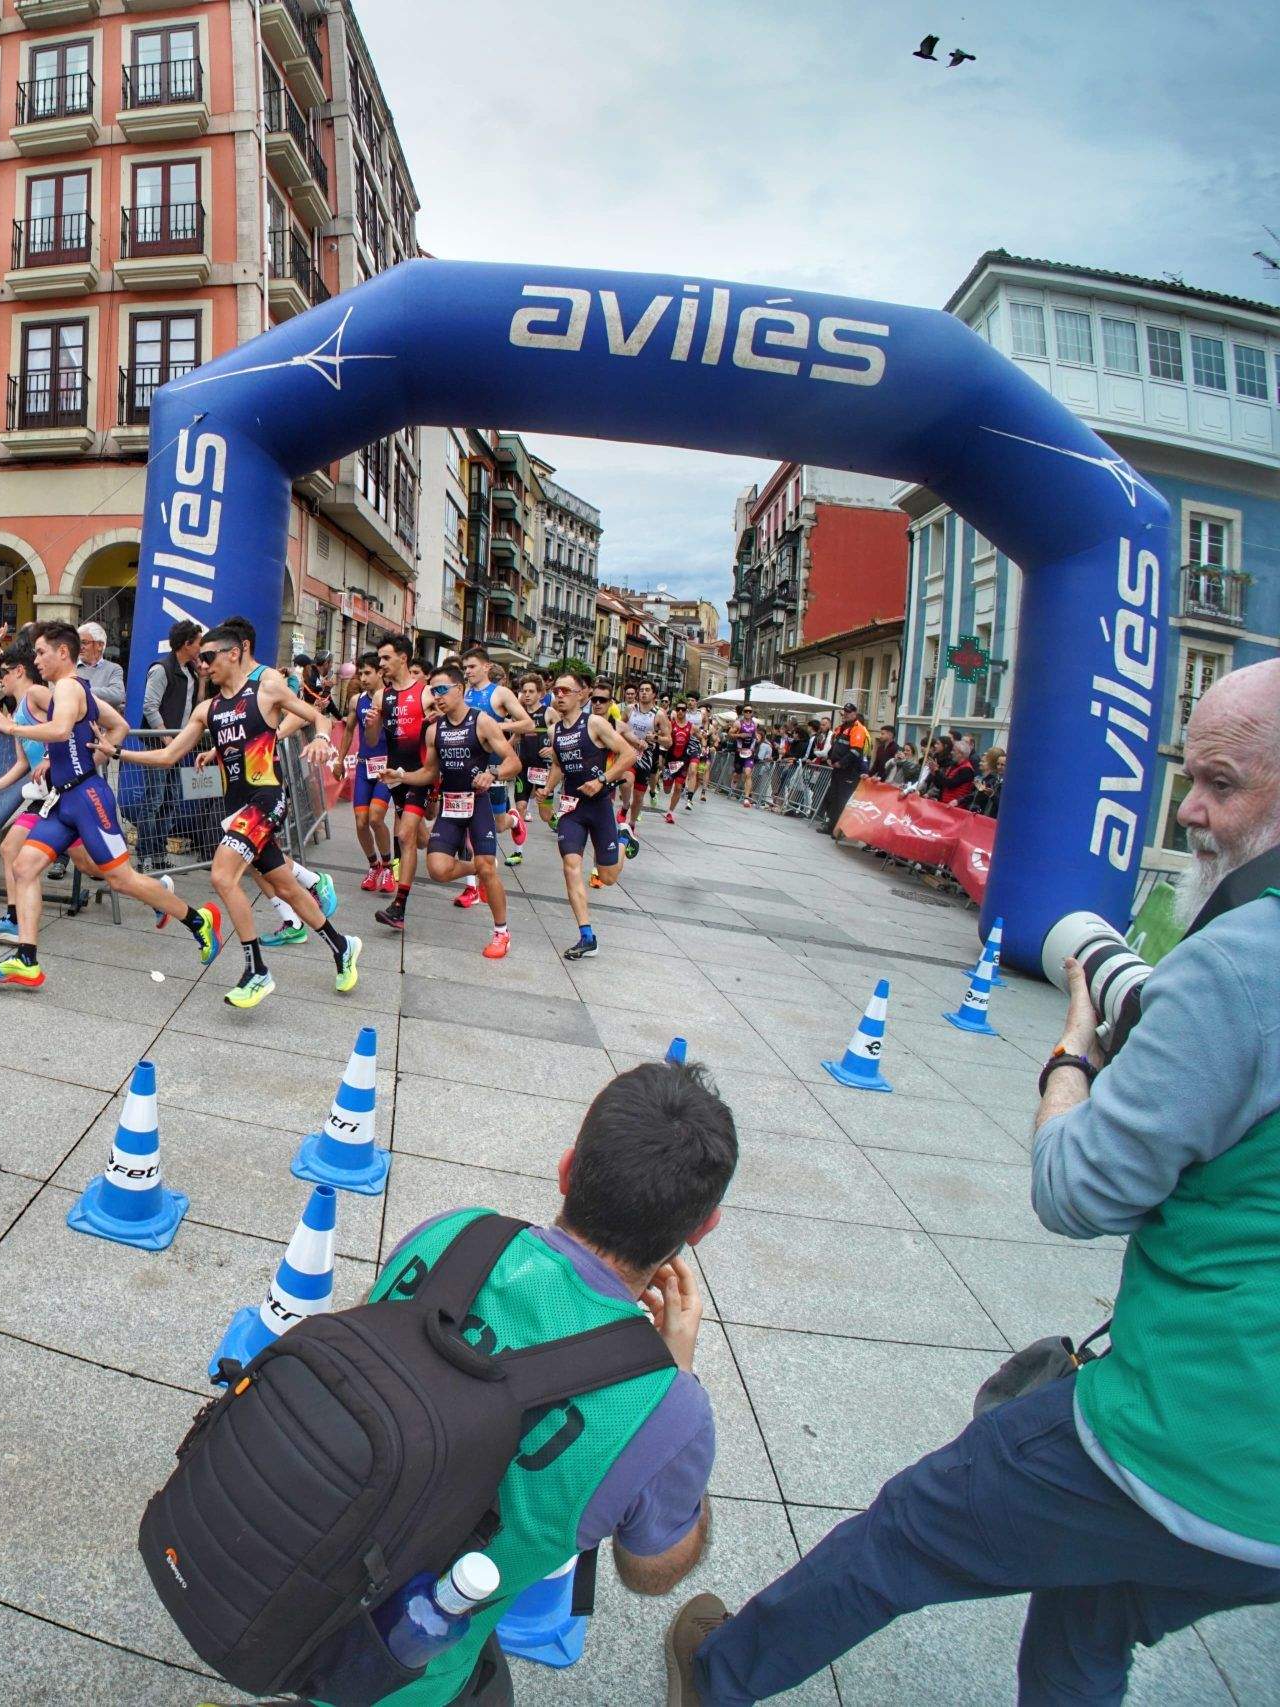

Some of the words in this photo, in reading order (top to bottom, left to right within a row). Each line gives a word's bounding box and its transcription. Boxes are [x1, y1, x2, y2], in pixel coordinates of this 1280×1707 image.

[509, 284, 889, 387] avilés
[151, 428, 228, 655] vilés
[217, 724, 246, 746] AYALA
[392, 705, 409, 717] JOVE
[1088, 536, 1161, 872] avilés
[440, 747, 471, 759] CASTEDO
